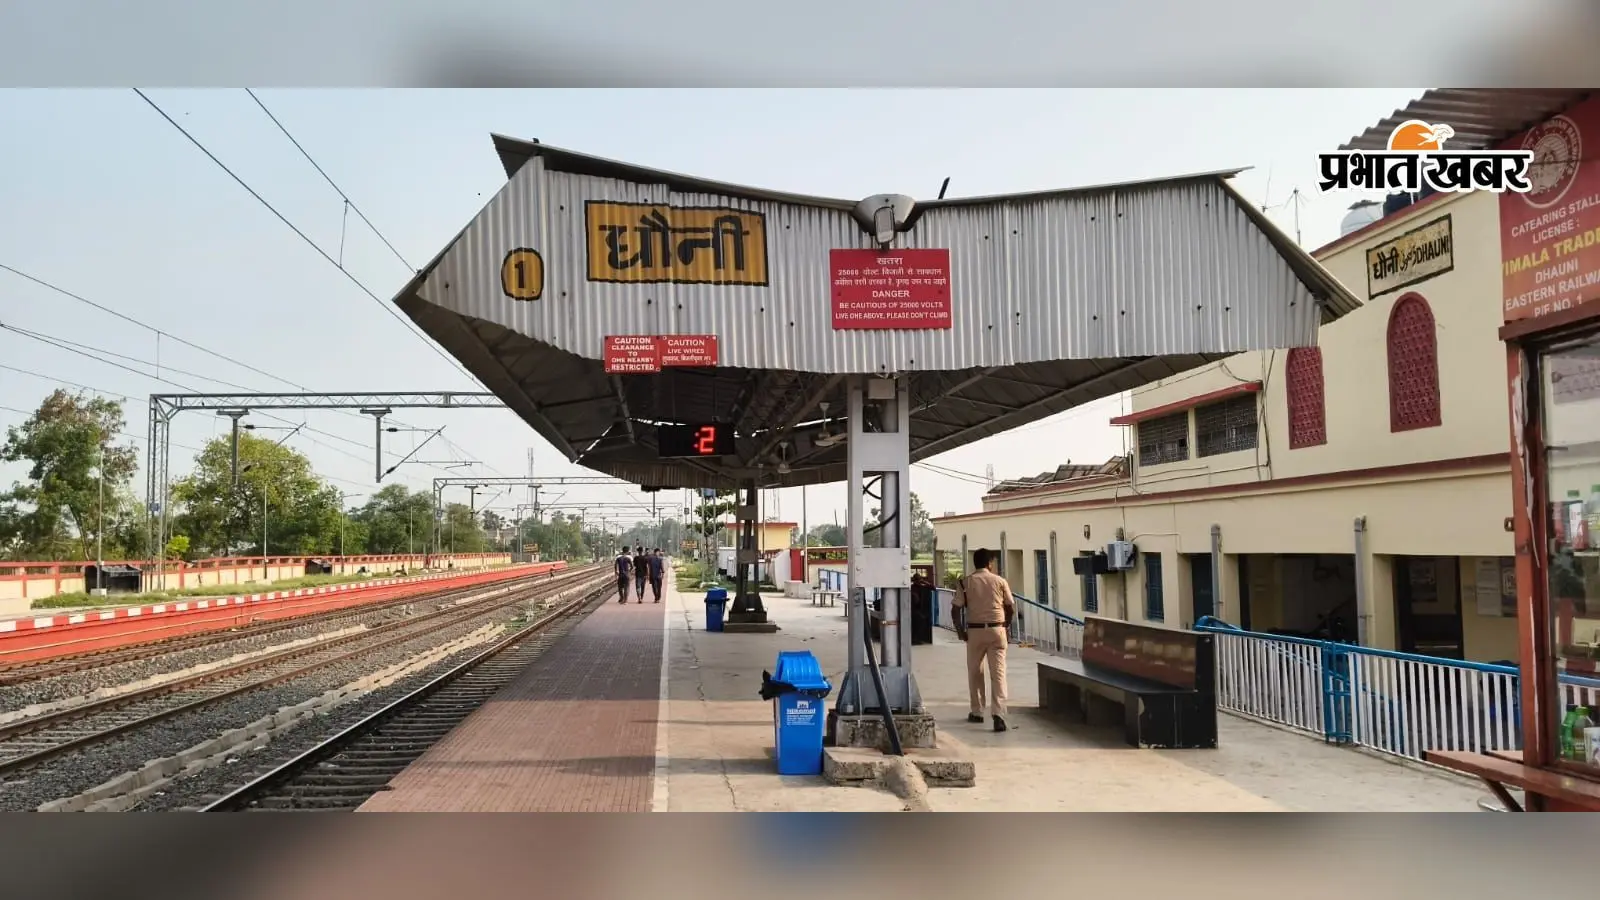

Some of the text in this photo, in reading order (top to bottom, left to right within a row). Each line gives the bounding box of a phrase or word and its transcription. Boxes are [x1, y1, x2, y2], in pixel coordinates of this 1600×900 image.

[1511, 207, 1566, 238] CATEARING
[598, 208, 750, 271] धौनी
[1416, 234, 1449, 265] DHAUNI
[876, 257, 904, 265] खतरा
[1535, 258, 1579, 284] DHAUNI
[514, 260, 525, 289] 1
[872, 290, 910, 298] DANGER
[920, 301, 944, 309] VOLTS
[1505, 284, 1556, 312] EASTERN
[1576, 292, 1582, 305] 1
[886, 312, 909, 320] PLEASE
[929, 311, 948, 319] CLIMB
